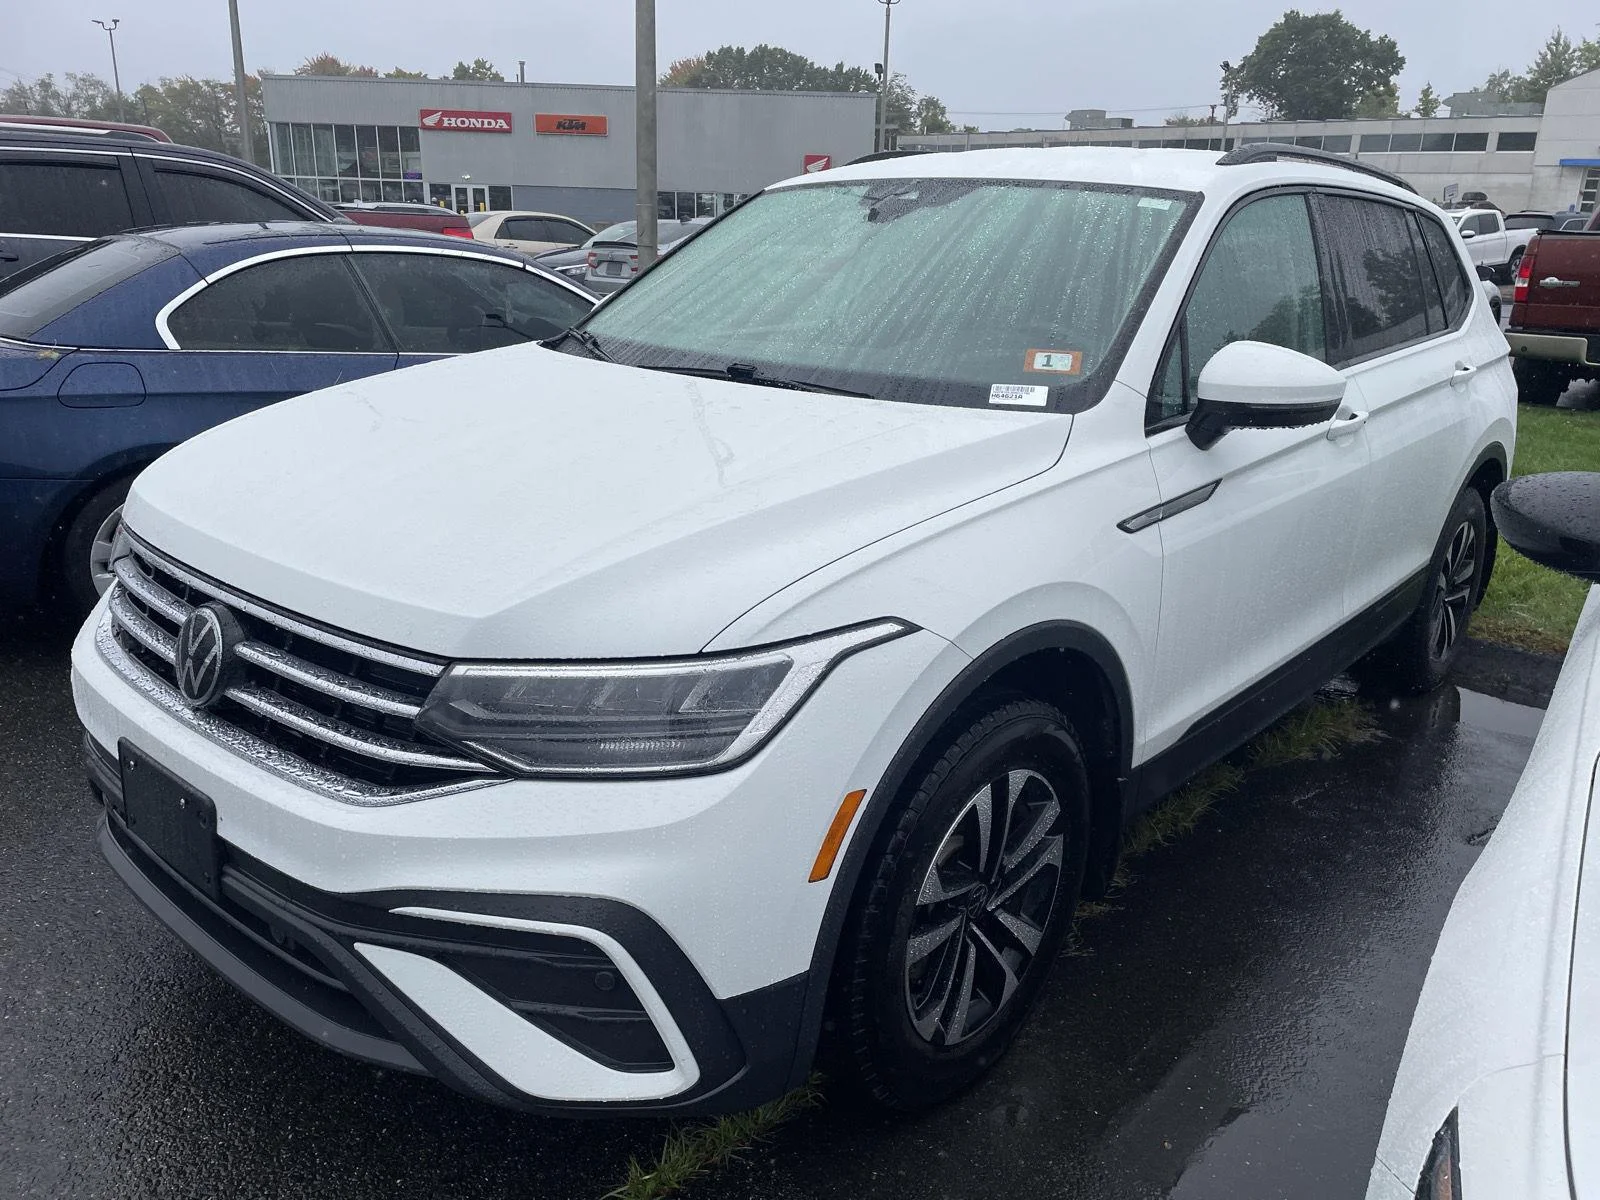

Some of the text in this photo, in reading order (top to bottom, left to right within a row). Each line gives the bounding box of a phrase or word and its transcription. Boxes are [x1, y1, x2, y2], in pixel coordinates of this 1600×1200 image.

[443, 117, 510, 129] HONDA
[556, 119, 586, 130] KTM
[1041, 354, 1053, 368] 1
